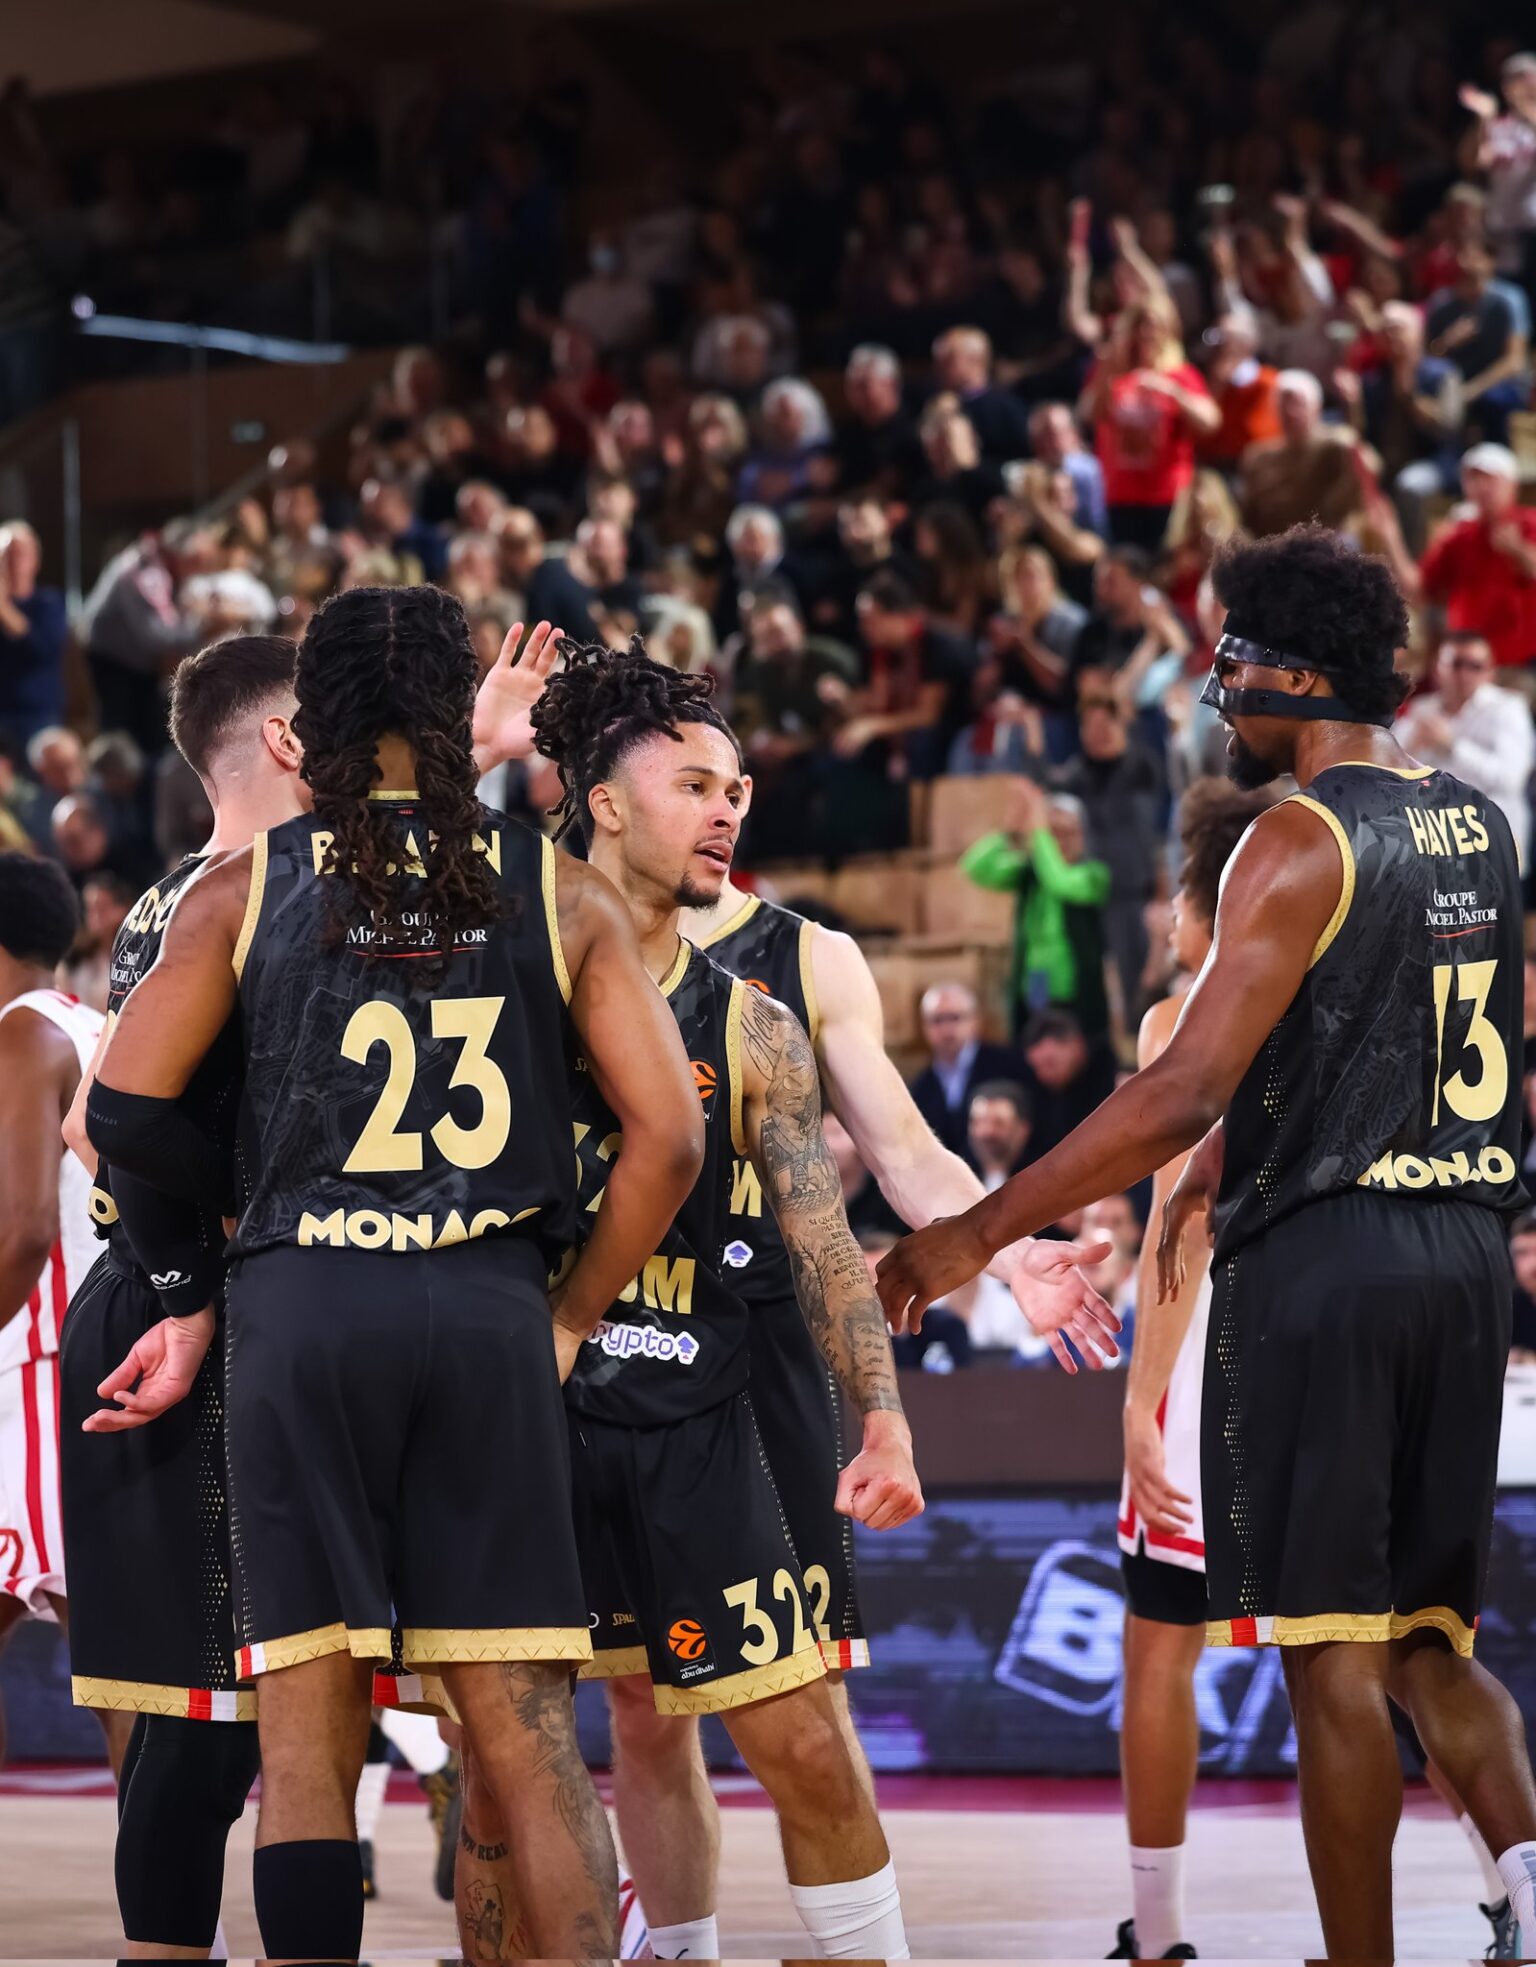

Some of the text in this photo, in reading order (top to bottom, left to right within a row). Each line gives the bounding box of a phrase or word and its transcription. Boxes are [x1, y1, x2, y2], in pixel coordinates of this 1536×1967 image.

[1404, 804, 1490, 857] HAYES
[1458, 907, 1498, 925] PASTOR
[1430, 959, 1508, 1127] 13
[340, 996, 511, 1173] 23
[592, 1324, 674, 1356] rypto
[722, 1567, 818, 1666] 32
